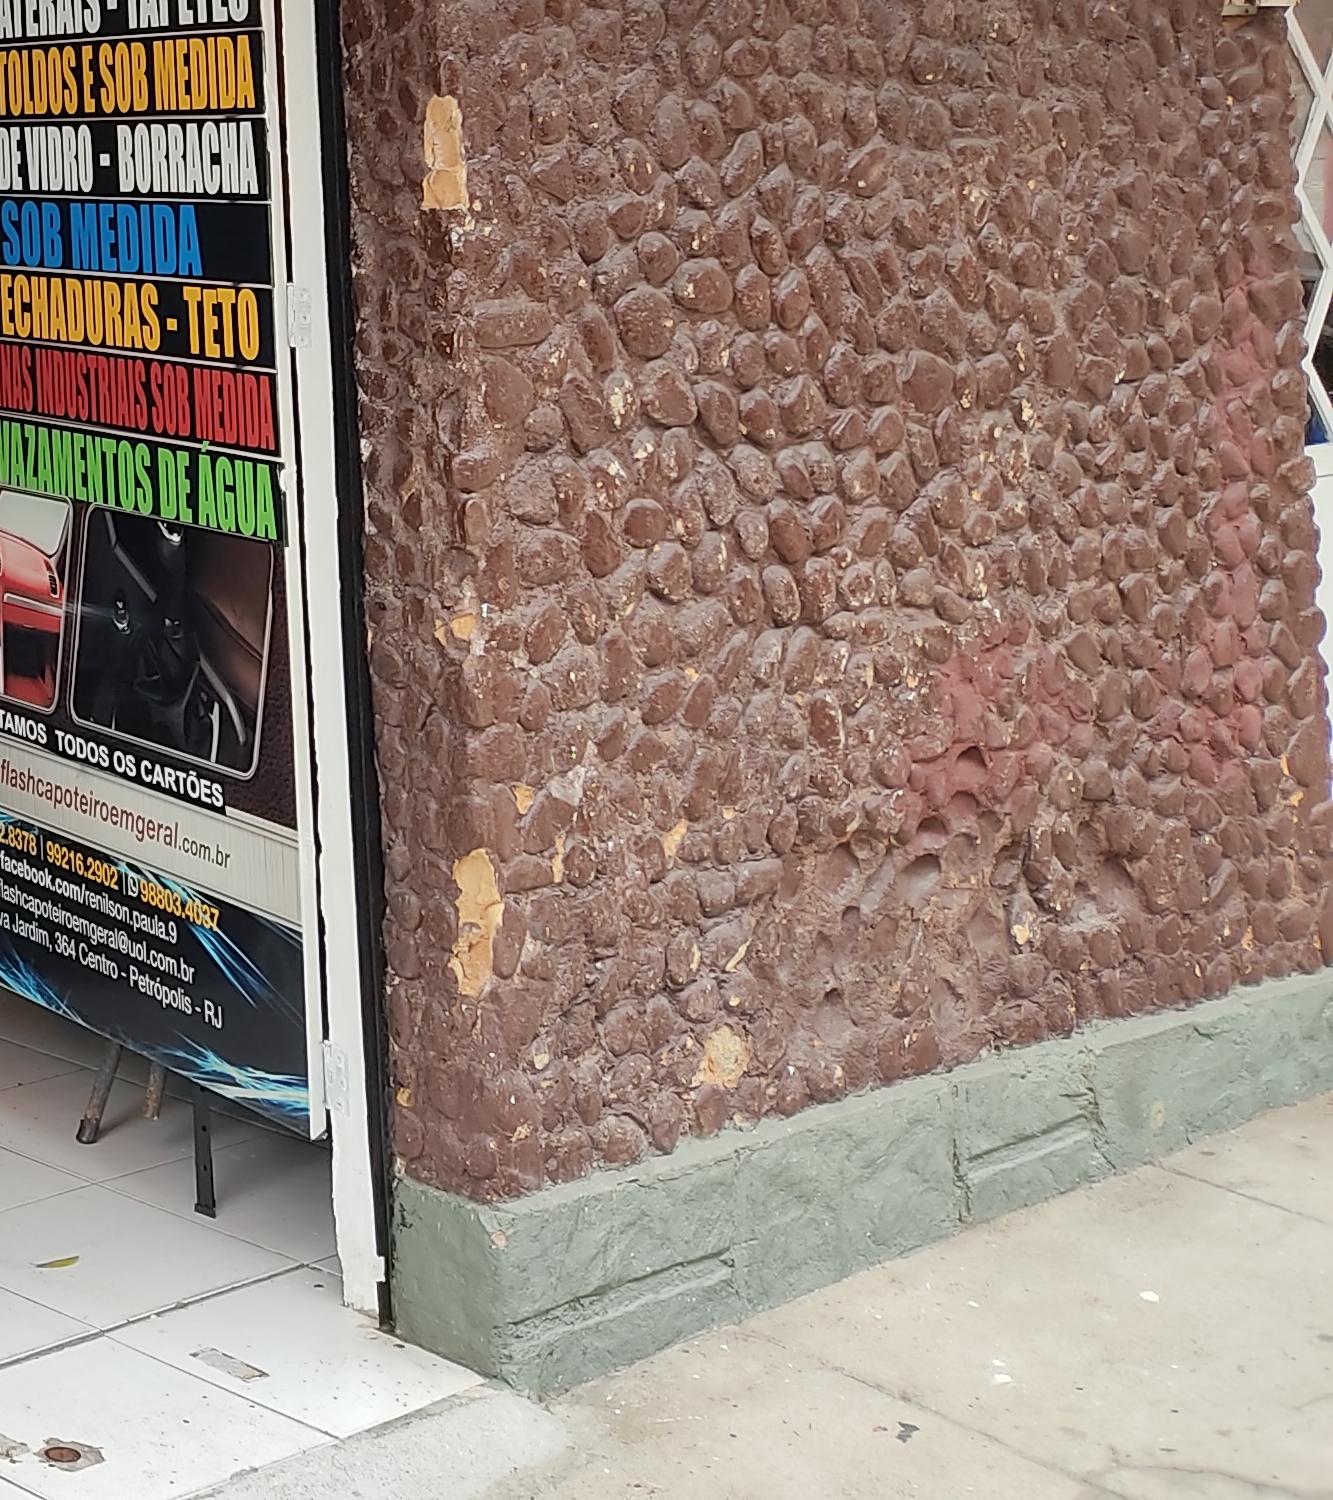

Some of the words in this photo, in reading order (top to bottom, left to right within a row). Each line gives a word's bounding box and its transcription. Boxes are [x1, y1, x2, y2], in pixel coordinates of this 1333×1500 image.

[82, 44, 95, 112] E
[99, 41, 149, 113] SOB
[153, 35, 256, 110] MEDIDA
[25, 124, 94, 193] VIDRO
[117, 121, 258, 196] BORRACHA
[1, 200, 62, 270] SOB
[71, 203, 203, 277] MEDIDA
[182, 286, 259, 360] TETO
[36, 348, 147, 432] INDUSTRIAIS
[150, 363, 190, 436] SOB
[194, 368, 275, 450] MEDIDA
[158, 449, 193, 523] DE
[198, 441, 276, 539] ÁGUA
[55, 730, 109, 767] TODOS
[113, 751, 136, 777] OS
[140, 760, 224, 807] CARTÕES
[0, 850, 178, 944] facebook.com/renilson.paula.9
[46, 841, 119, 890] 99216.2902
[140, 880, 220, 931] 98803.4037
[12, 913, 53, 952] Jardim,
[54, 931, 76, 954] 364
[78, 942, 118, 979] Centro
[129, 966, 192, 1015] Petrópolis
[203, 1000, 222, 1029] RJ
